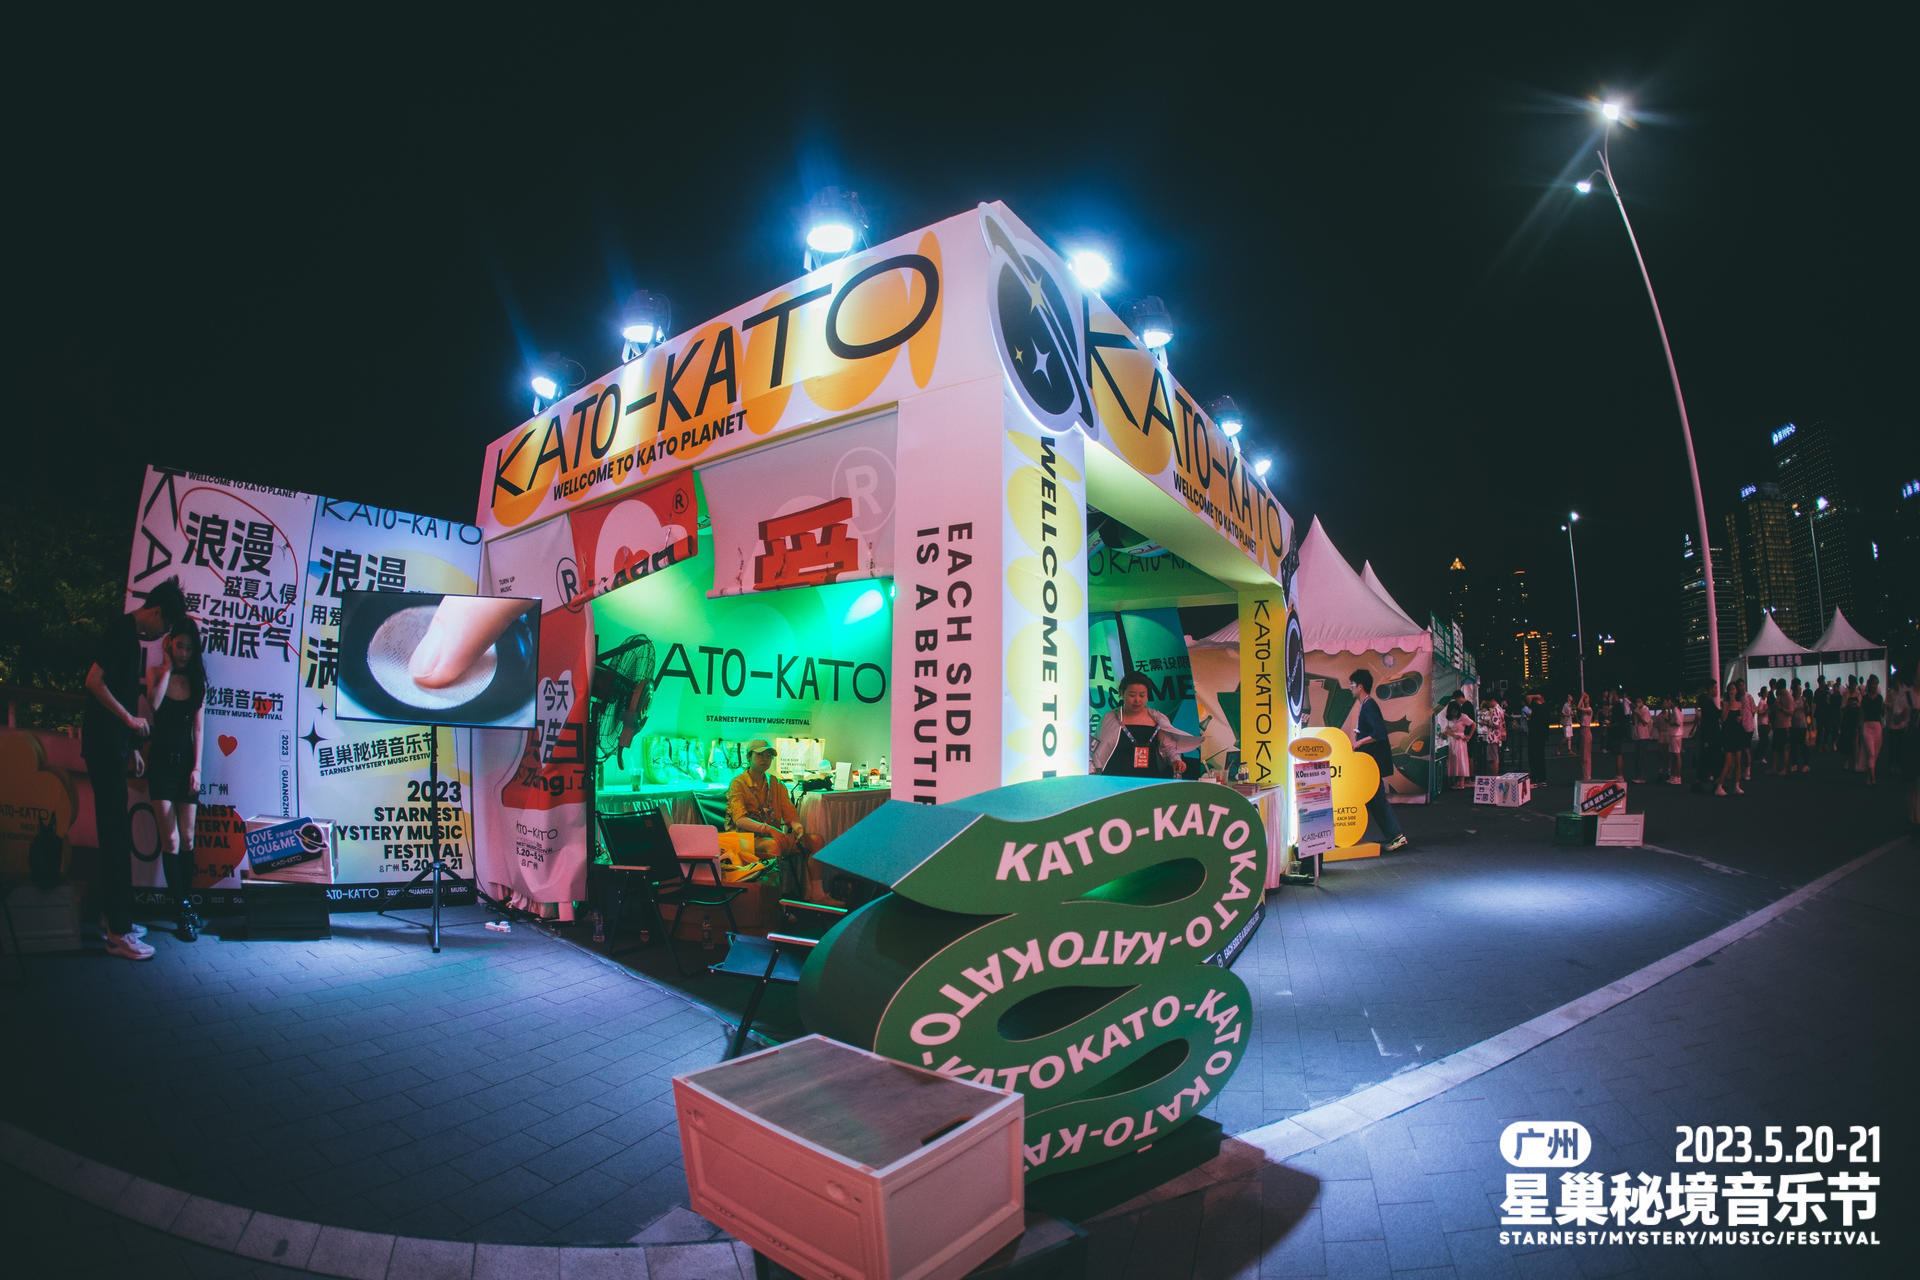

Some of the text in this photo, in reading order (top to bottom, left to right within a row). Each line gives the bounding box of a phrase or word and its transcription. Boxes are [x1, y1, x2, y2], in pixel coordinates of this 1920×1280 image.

[491, 254, 939, 507] KATO-KATO
[1083, 292, 1283, 557] KATO-KATO
[553, 409, 748, 501] WELLCOME TO KATO PLANET
[233, 479, 243, 489] TO
[244, 482, 267, 494] KATO
[267, 486, 298, 499] PLANET
[1173, 470, 1213, 519] WELLCOME
[1214, 506, 1223, 526] TO
[1224, 515, 1239, 540] KATO
[181, 511, 275, 576] 浪漫
[916, 527, 939, 564] IS
[1041, 436, 1058, 683] WELLCOME
[223, 575, 297, 605] 盛夏入侵
[316, 546, 406, 598] 浪漫
[915, 585, 938, 610] A
[200, 618, 291, 662] 满底气
[946, 522, 972, 763] EACH SIDE
[1254, 600, 1272, 735] KATO-KATO
[706, 715, 810, 726] STARNEST MYSTERY MUSIC FESTIVAL
[1042, 694, 1057, 757] TO
[320, 766, 354, 777] STARNEST
[355, 760, 386, 772] MYSTERY
[387, 756, 409, 765] MUSIC
[209, 783, 228, 795] 广州
[407, 780, 462, 802] 2023
[246, 830, 273, 846] LOVE
[249, 836, 297, 857] YOU&ME
